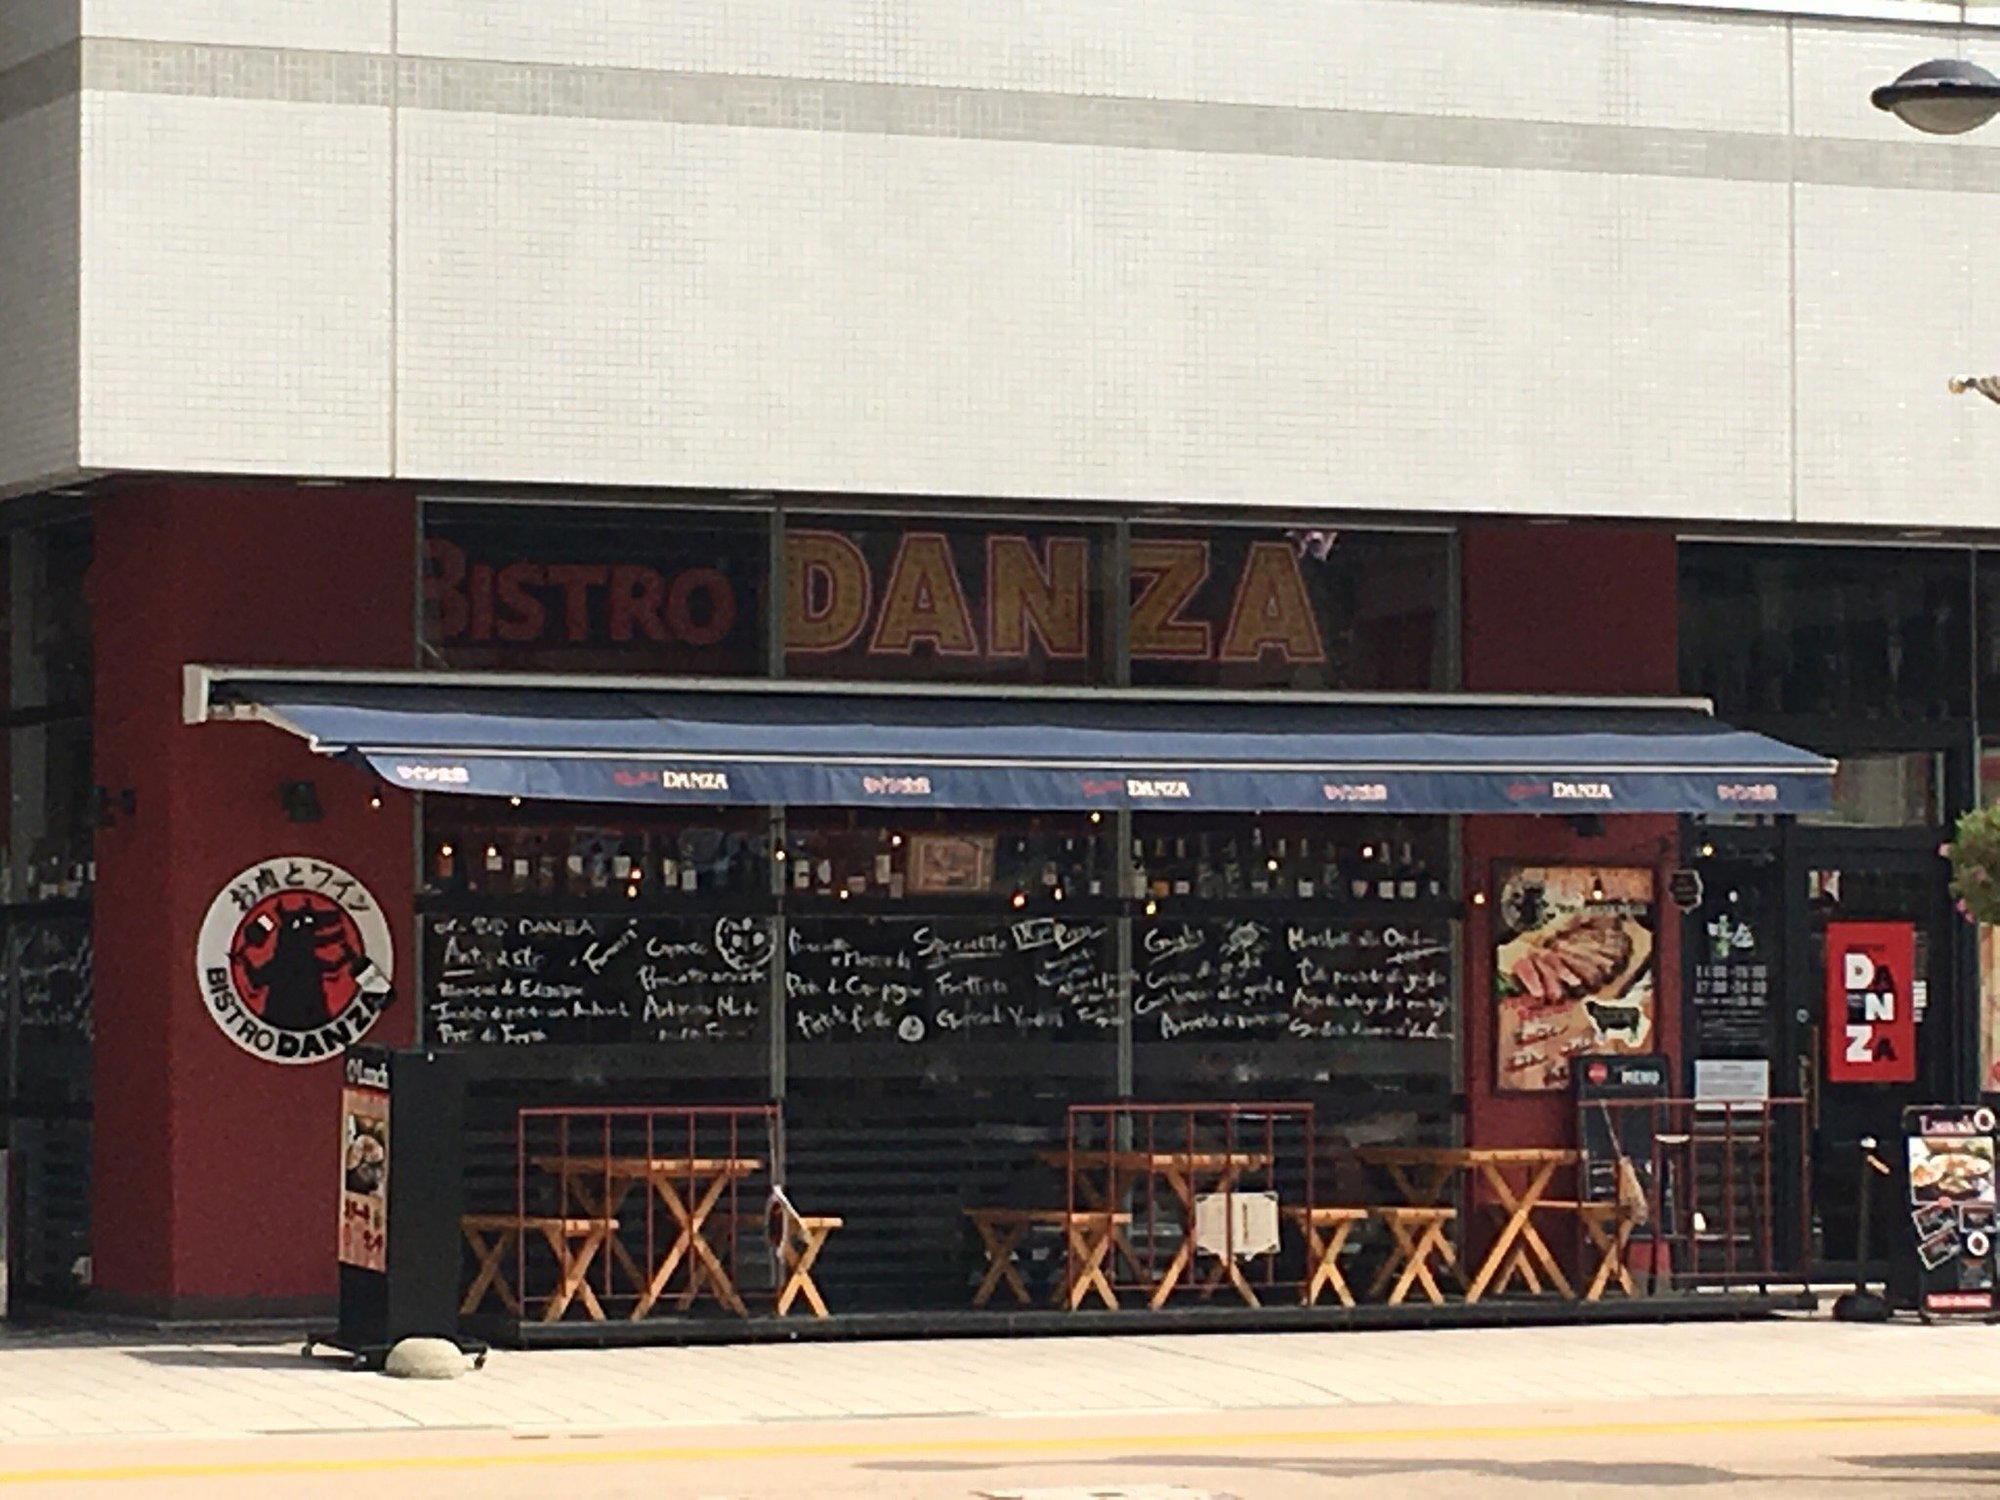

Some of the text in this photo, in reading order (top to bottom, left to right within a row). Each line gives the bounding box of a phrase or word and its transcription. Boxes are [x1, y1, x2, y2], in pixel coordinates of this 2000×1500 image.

[422, 529, 1326, 664] BISTRO DANZA
[663, 770, 729, 790] DANZA
[1127, 780, 1191, 798] DANZA
[1552, 782, 1613, 799] DANZA
[206, 967, 395, 1058] BISTRO DANZA
